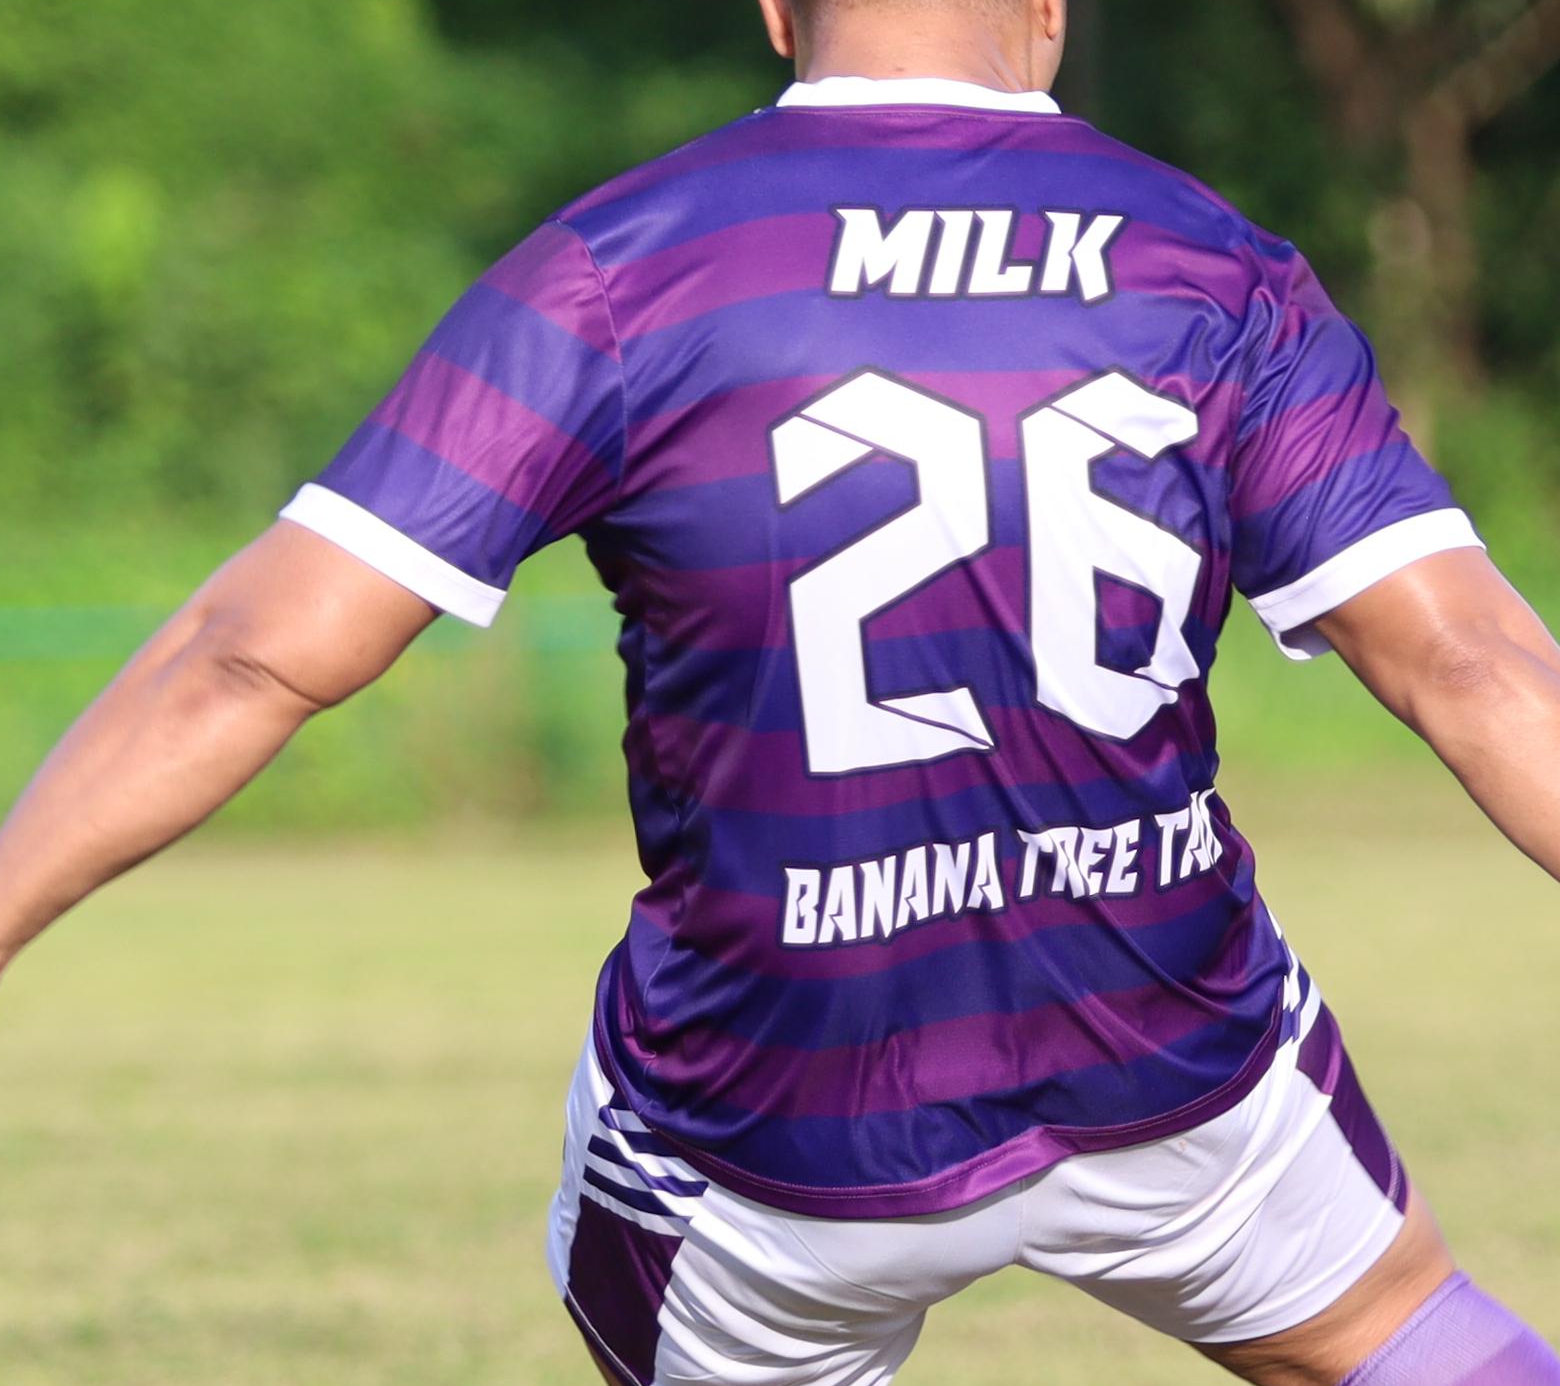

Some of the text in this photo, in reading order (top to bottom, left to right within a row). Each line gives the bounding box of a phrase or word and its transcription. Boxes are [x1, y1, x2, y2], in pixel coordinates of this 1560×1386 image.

[829, 207, 1124, 302] MILK
[770, 370, 1203, 775] 26
[782, 831, 1005, 945] BANANA
[1016, 818, 1141, 899] TREE
